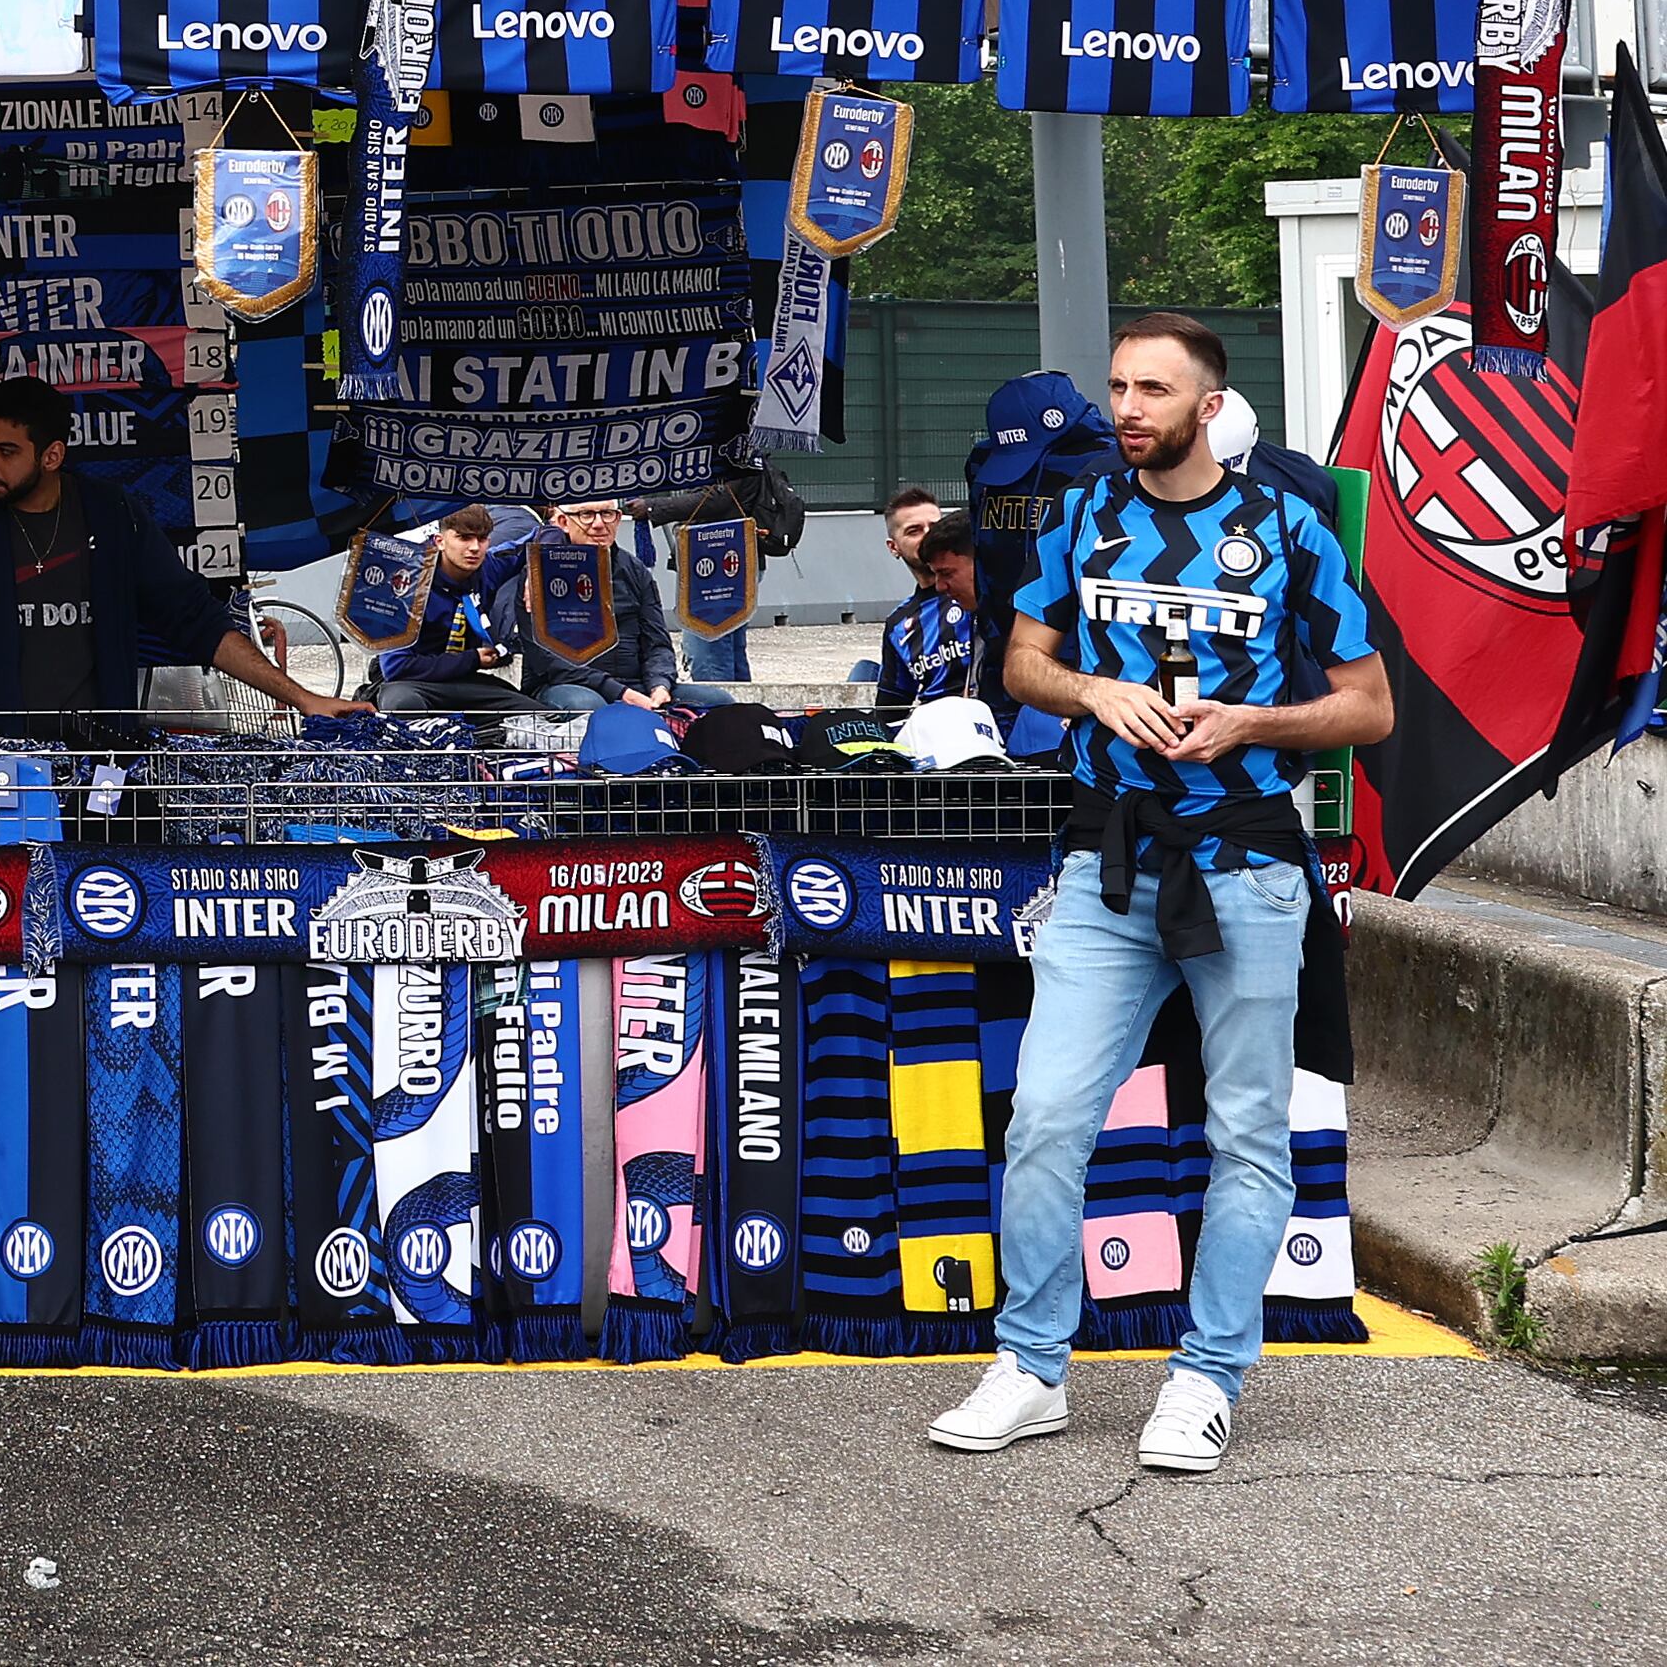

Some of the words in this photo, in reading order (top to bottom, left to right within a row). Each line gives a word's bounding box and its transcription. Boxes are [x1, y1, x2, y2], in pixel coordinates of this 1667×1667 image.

[159, 15, 327, 53] Lenovo
[472, 3, 614, 40] Lenovo
[772, 17, 924, 61] Lenovo
[1060, 21, 1200, 64] Lenovo
[1496, 84, 1531, 221] MILAN
[378, 126, 407, 251] INTER
[1391, 175, 1439, 192] Euroderby
[39, 341, 145, 384] INTER
[997, 427, 1027, 445] INTER
[549, 860, 663, 887] 16/05/2023
[173, 897, 297, 938] INTER
[539, 890, 669, 933] MILAN
[308, 917, 529, 963] EURODERBY
[736, 1034, 782, 1163] MILANO
